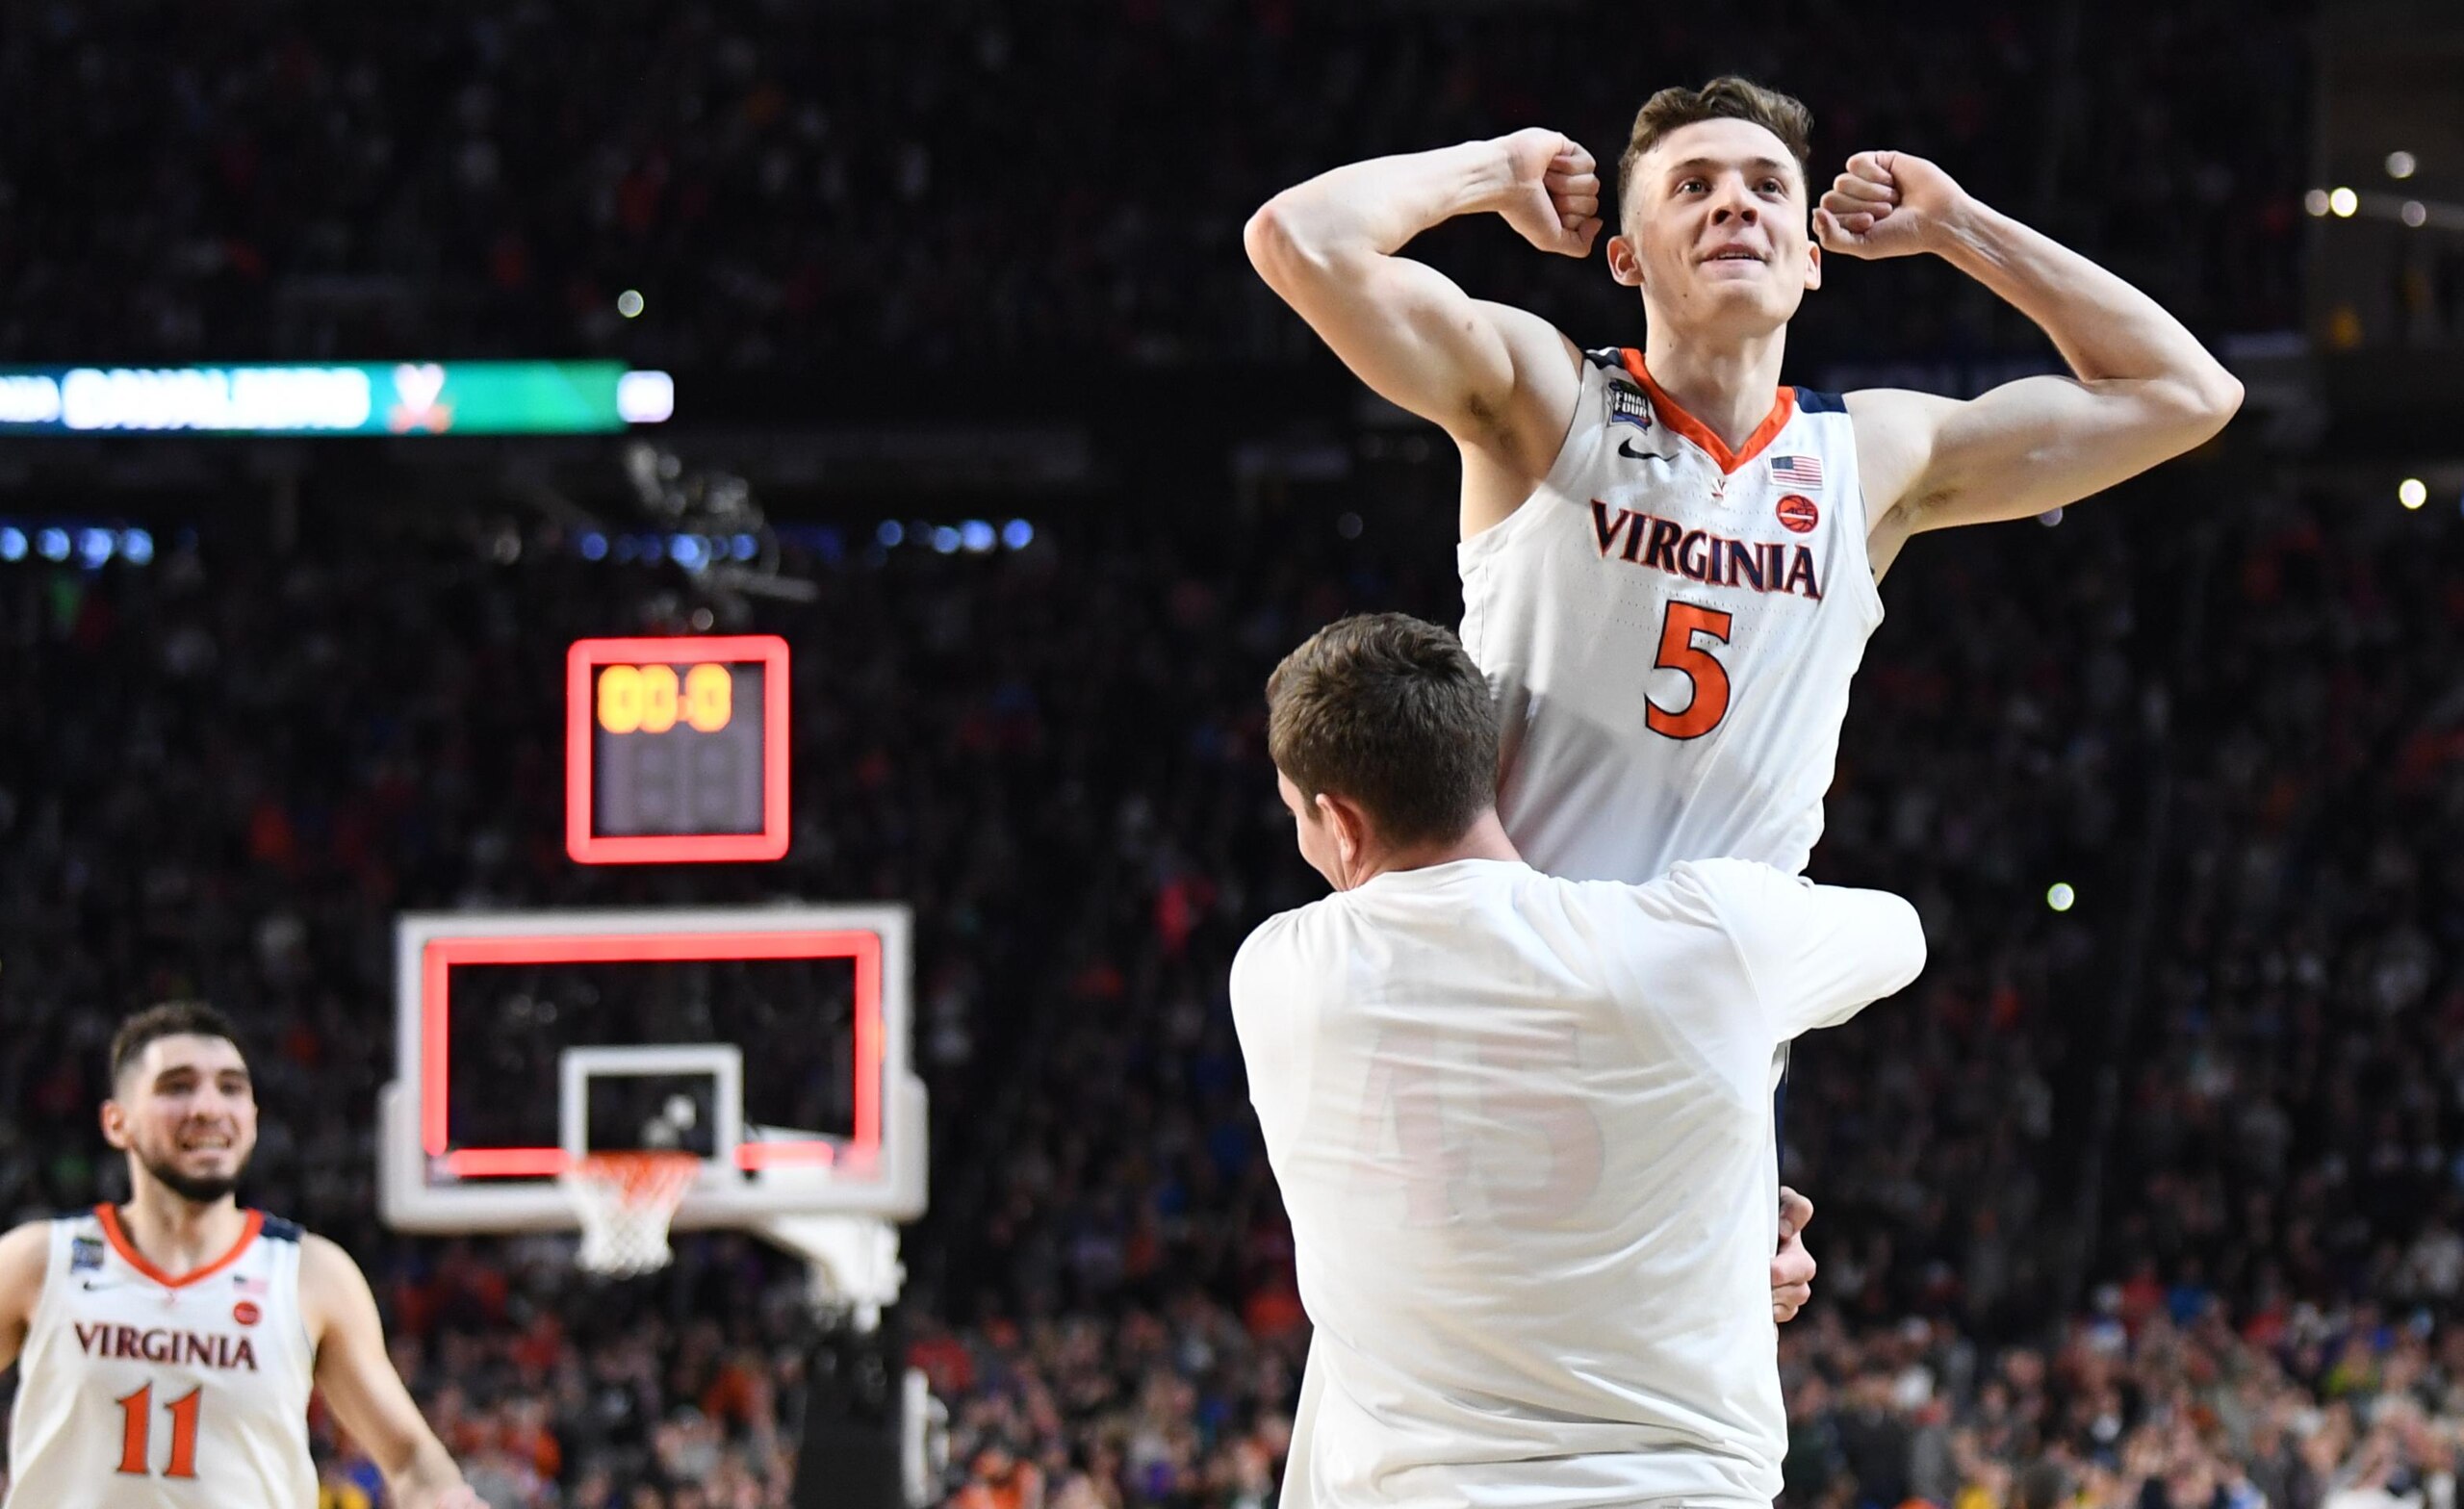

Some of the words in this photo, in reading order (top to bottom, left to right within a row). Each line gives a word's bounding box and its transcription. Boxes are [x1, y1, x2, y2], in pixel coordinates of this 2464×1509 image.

[1614, 401, 1647, 419] FOUR
[1615, 390, 1646, 407] FINAL
[1591, 499, 1822, 601] VIRGINIA
[1643, 599, 1732, 741] 5
[74, 1322, 257, 1371] VIRGINIA
[116, 1381, 201, 1479] 11
